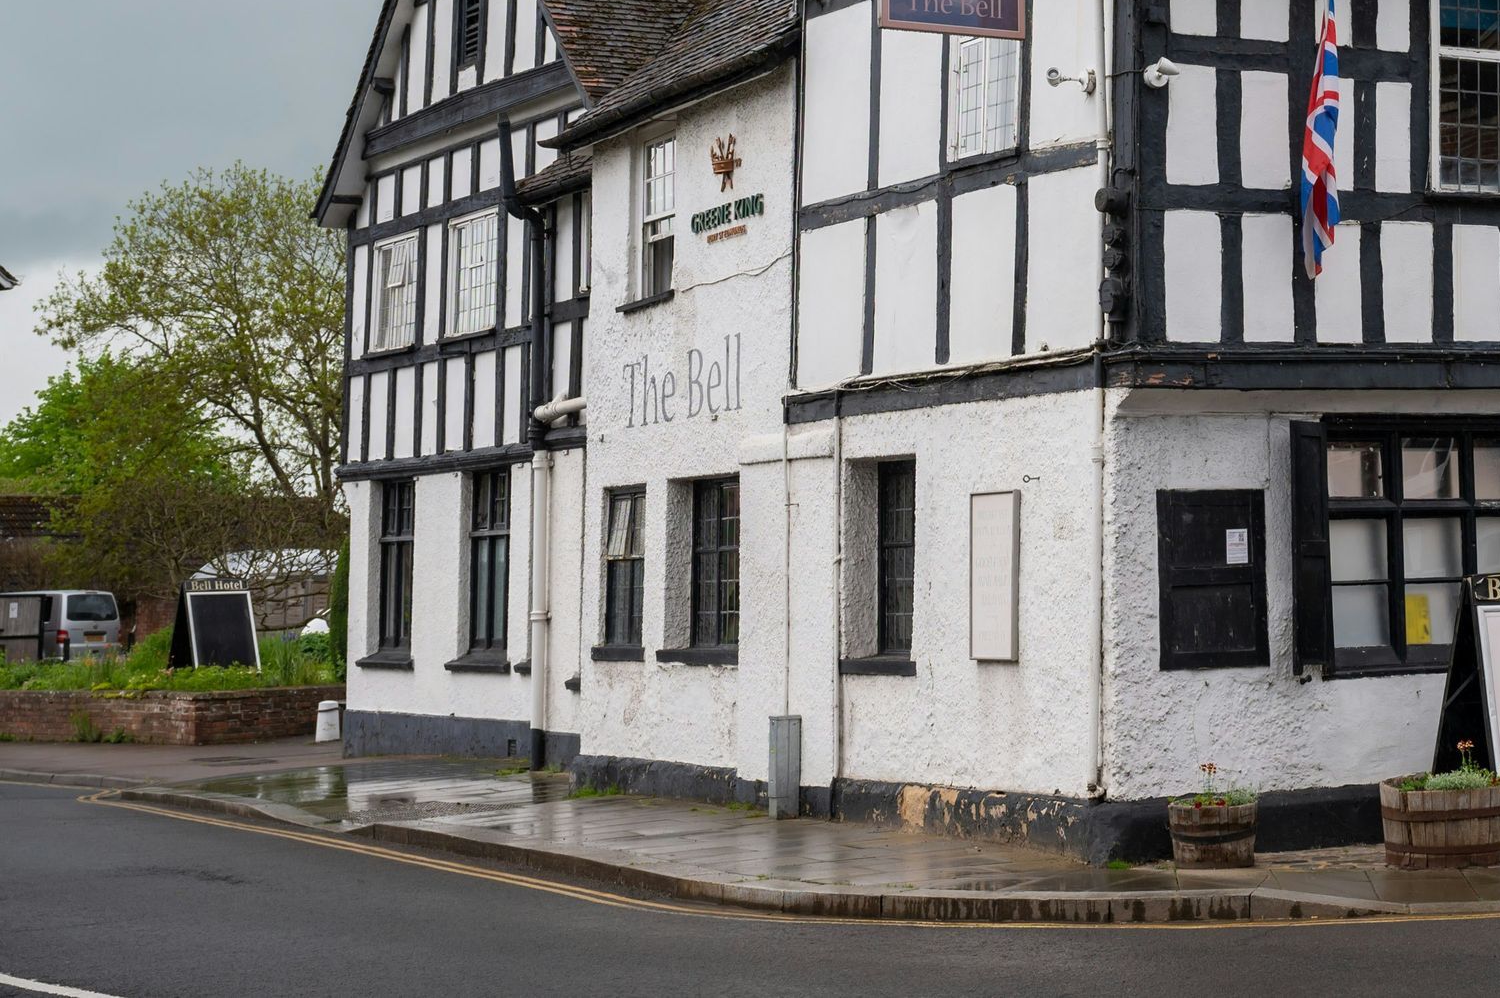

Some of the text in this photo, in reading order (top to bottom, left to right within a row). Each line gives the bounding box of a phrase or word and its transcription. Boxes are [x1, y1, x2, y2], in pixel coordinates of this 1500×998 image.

[691, 193, 764, 234] GREENE KING
[622, 332, 743, 428] The Bell
[191, 580, 243, 591] Bell Hotel
